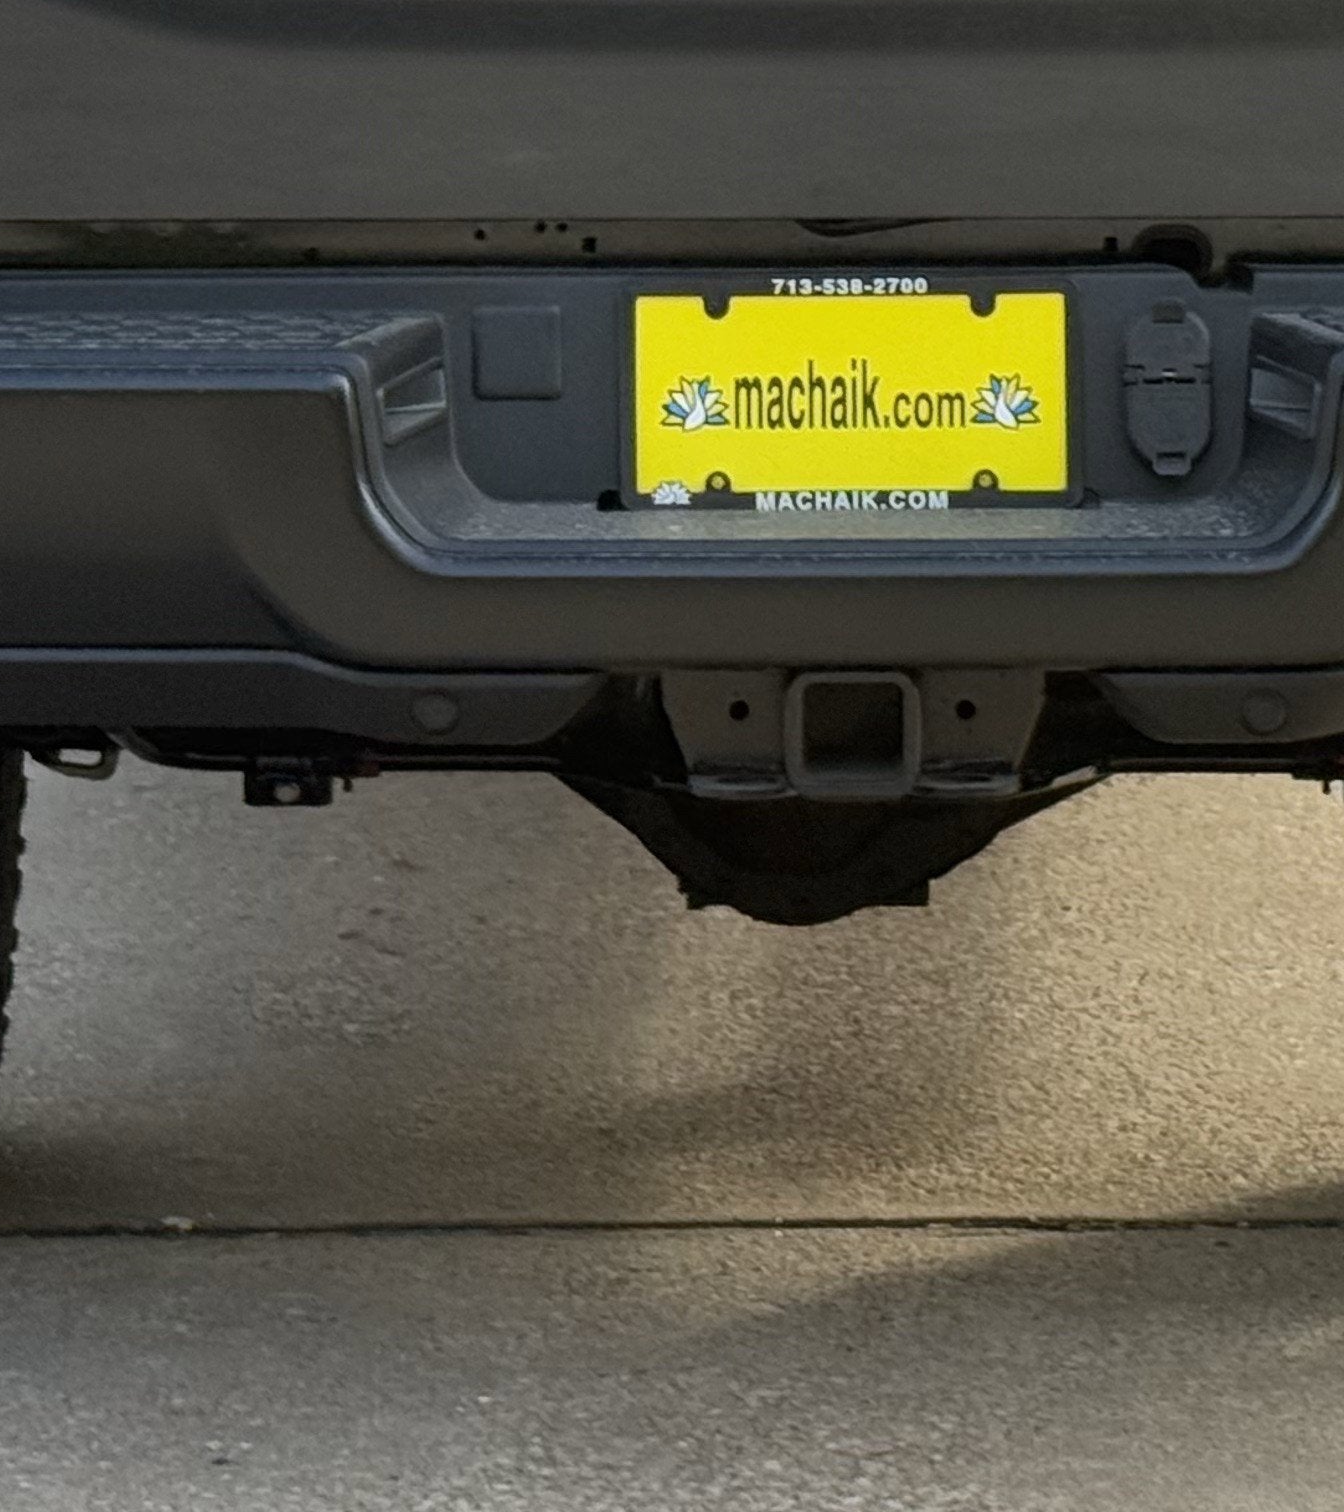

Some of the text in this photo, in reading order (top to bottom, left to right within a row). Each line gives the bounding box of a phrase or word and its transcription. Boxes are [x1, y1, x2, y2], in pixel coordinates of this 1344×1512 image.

[771, 277, 929, 295] 713-538-2700
[734, 358, 966, 430] machaik.com
[756, 490, 950, 511] MACHAIK.COM
